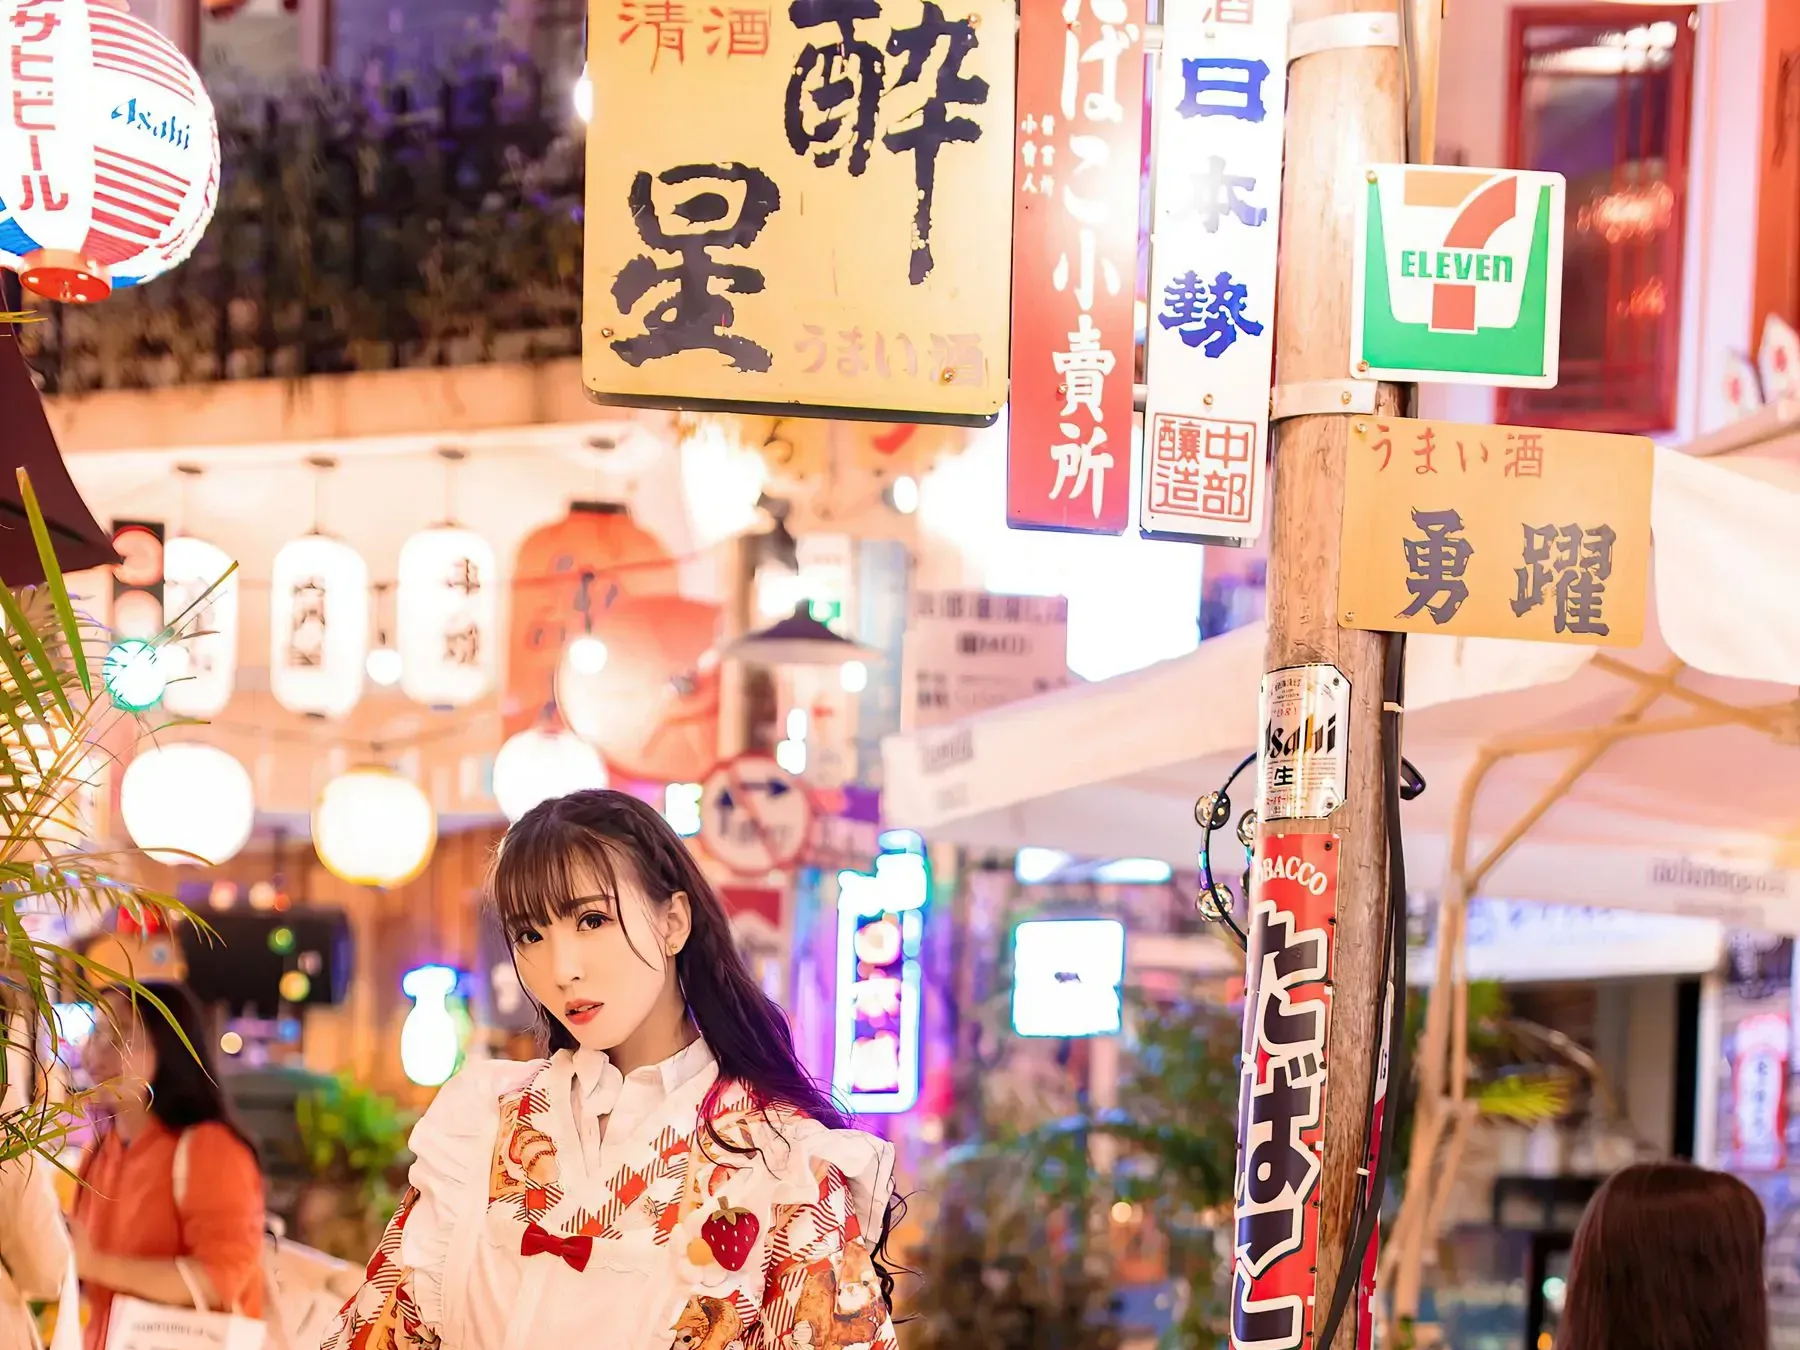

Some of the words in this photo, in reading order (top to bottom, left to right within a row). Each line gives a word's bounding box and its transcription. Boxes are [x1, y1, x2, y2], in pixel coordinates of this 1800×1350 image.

[617, 0, 771, 75] 清酒
[9, 0, 69, 211] サヒビール
[110, 97, 191, 150] Asahi
[610, 162, 780, 373] 星
[1048, 0, 1140, 520] ばこ小賣所
[793, 323, 988, 387] うまい酒
[1370, 424, 1545, 480] うまい酒
[1273, 765, 1294, 787] 生
